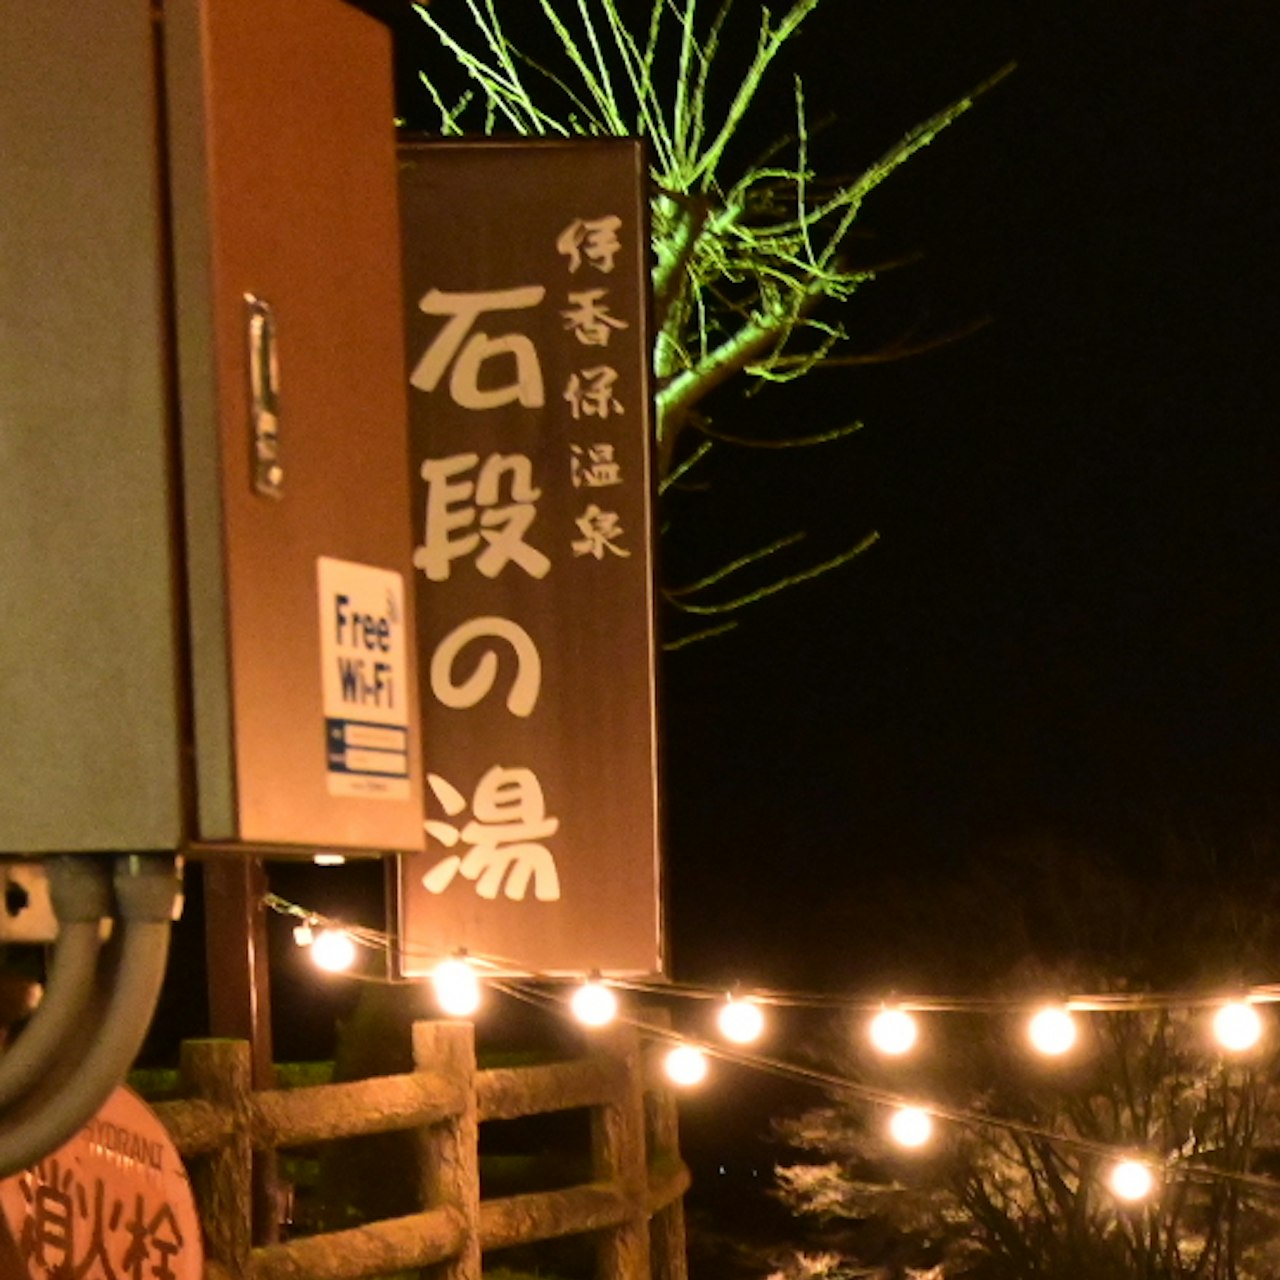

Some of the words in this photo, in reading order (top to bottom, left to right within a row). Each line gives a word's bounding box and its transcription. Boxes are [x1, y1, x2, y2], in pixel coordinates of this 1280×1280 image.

[557, 213, 632, 561] 伊香保温泉
[334, 593, 392, 653] Free
[337, 655, 395, 710] Wi-Fi
[409, 285, 561, 902] 石段の湯
